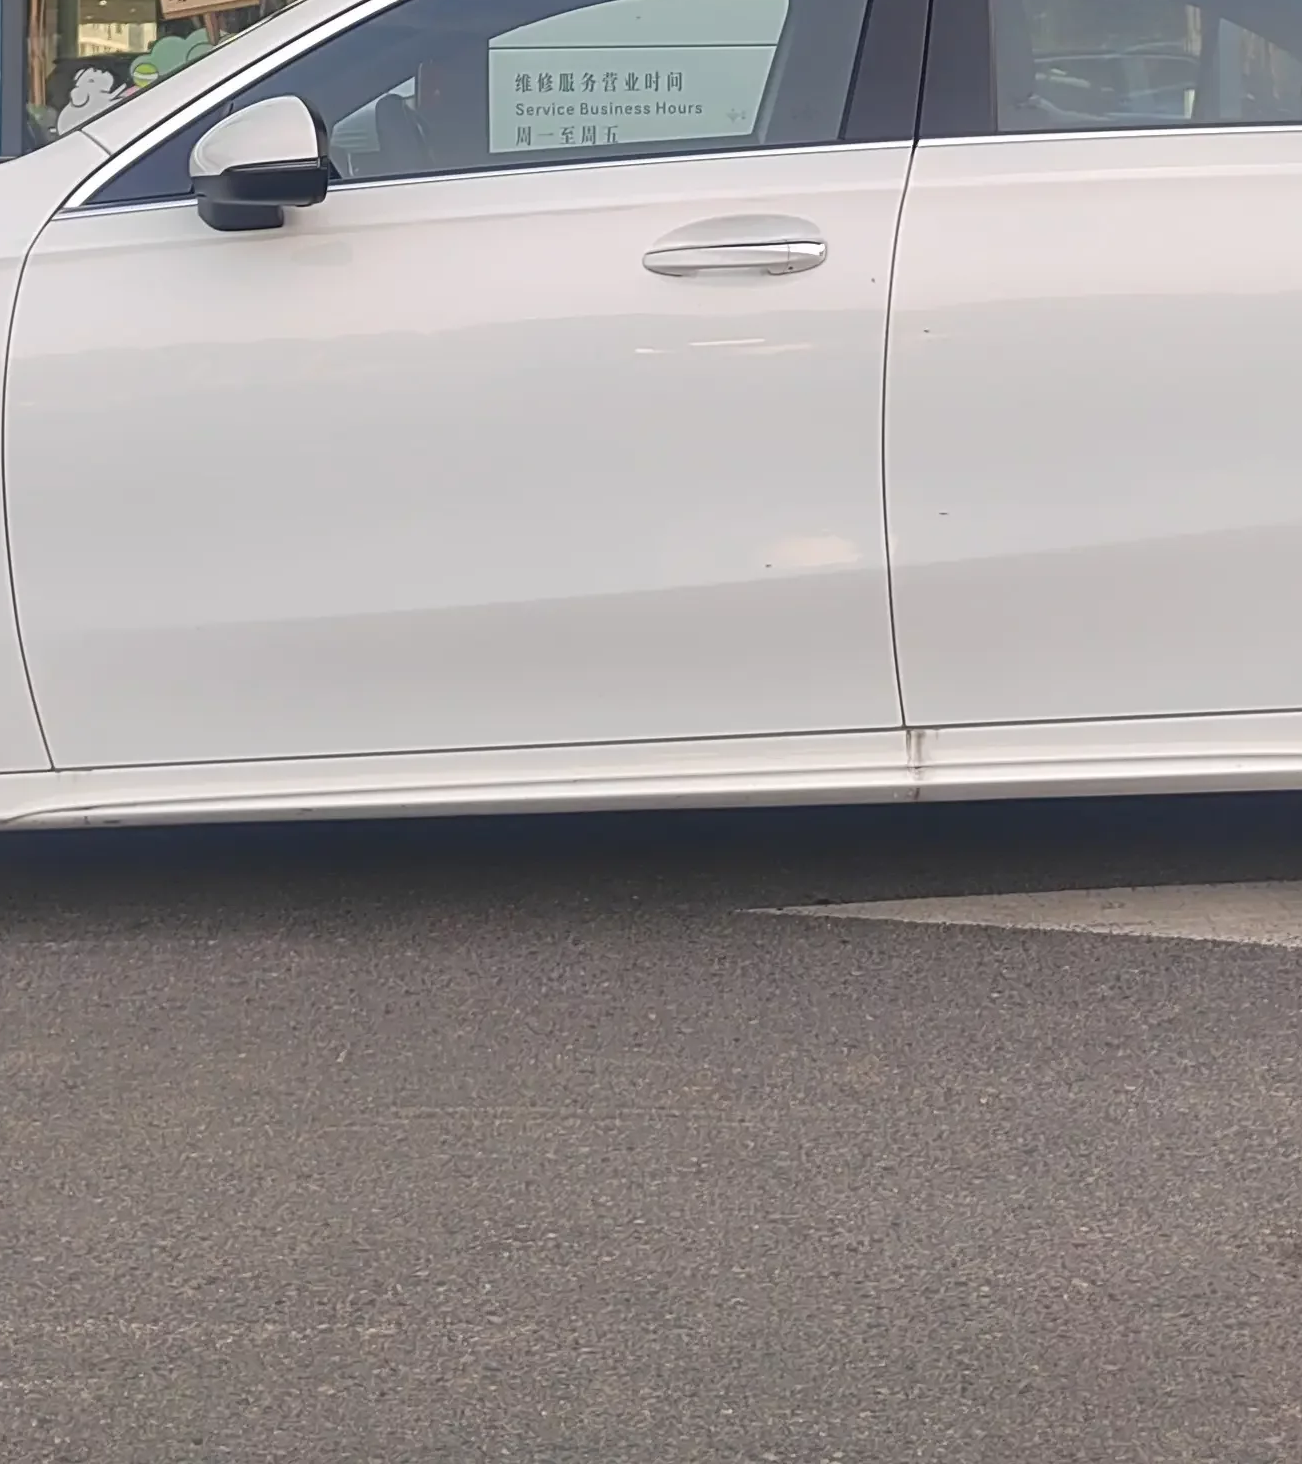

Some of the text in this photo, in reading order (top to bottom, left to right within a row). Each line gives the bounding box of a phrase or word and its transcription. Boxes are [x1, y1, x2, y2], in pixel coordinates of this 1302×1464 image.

[514, 71, 684, 93] 维修服务营业时间
[514, 100, 703, 117] Service Business Hours
[515, 125, 620, 146] 周一至周五
